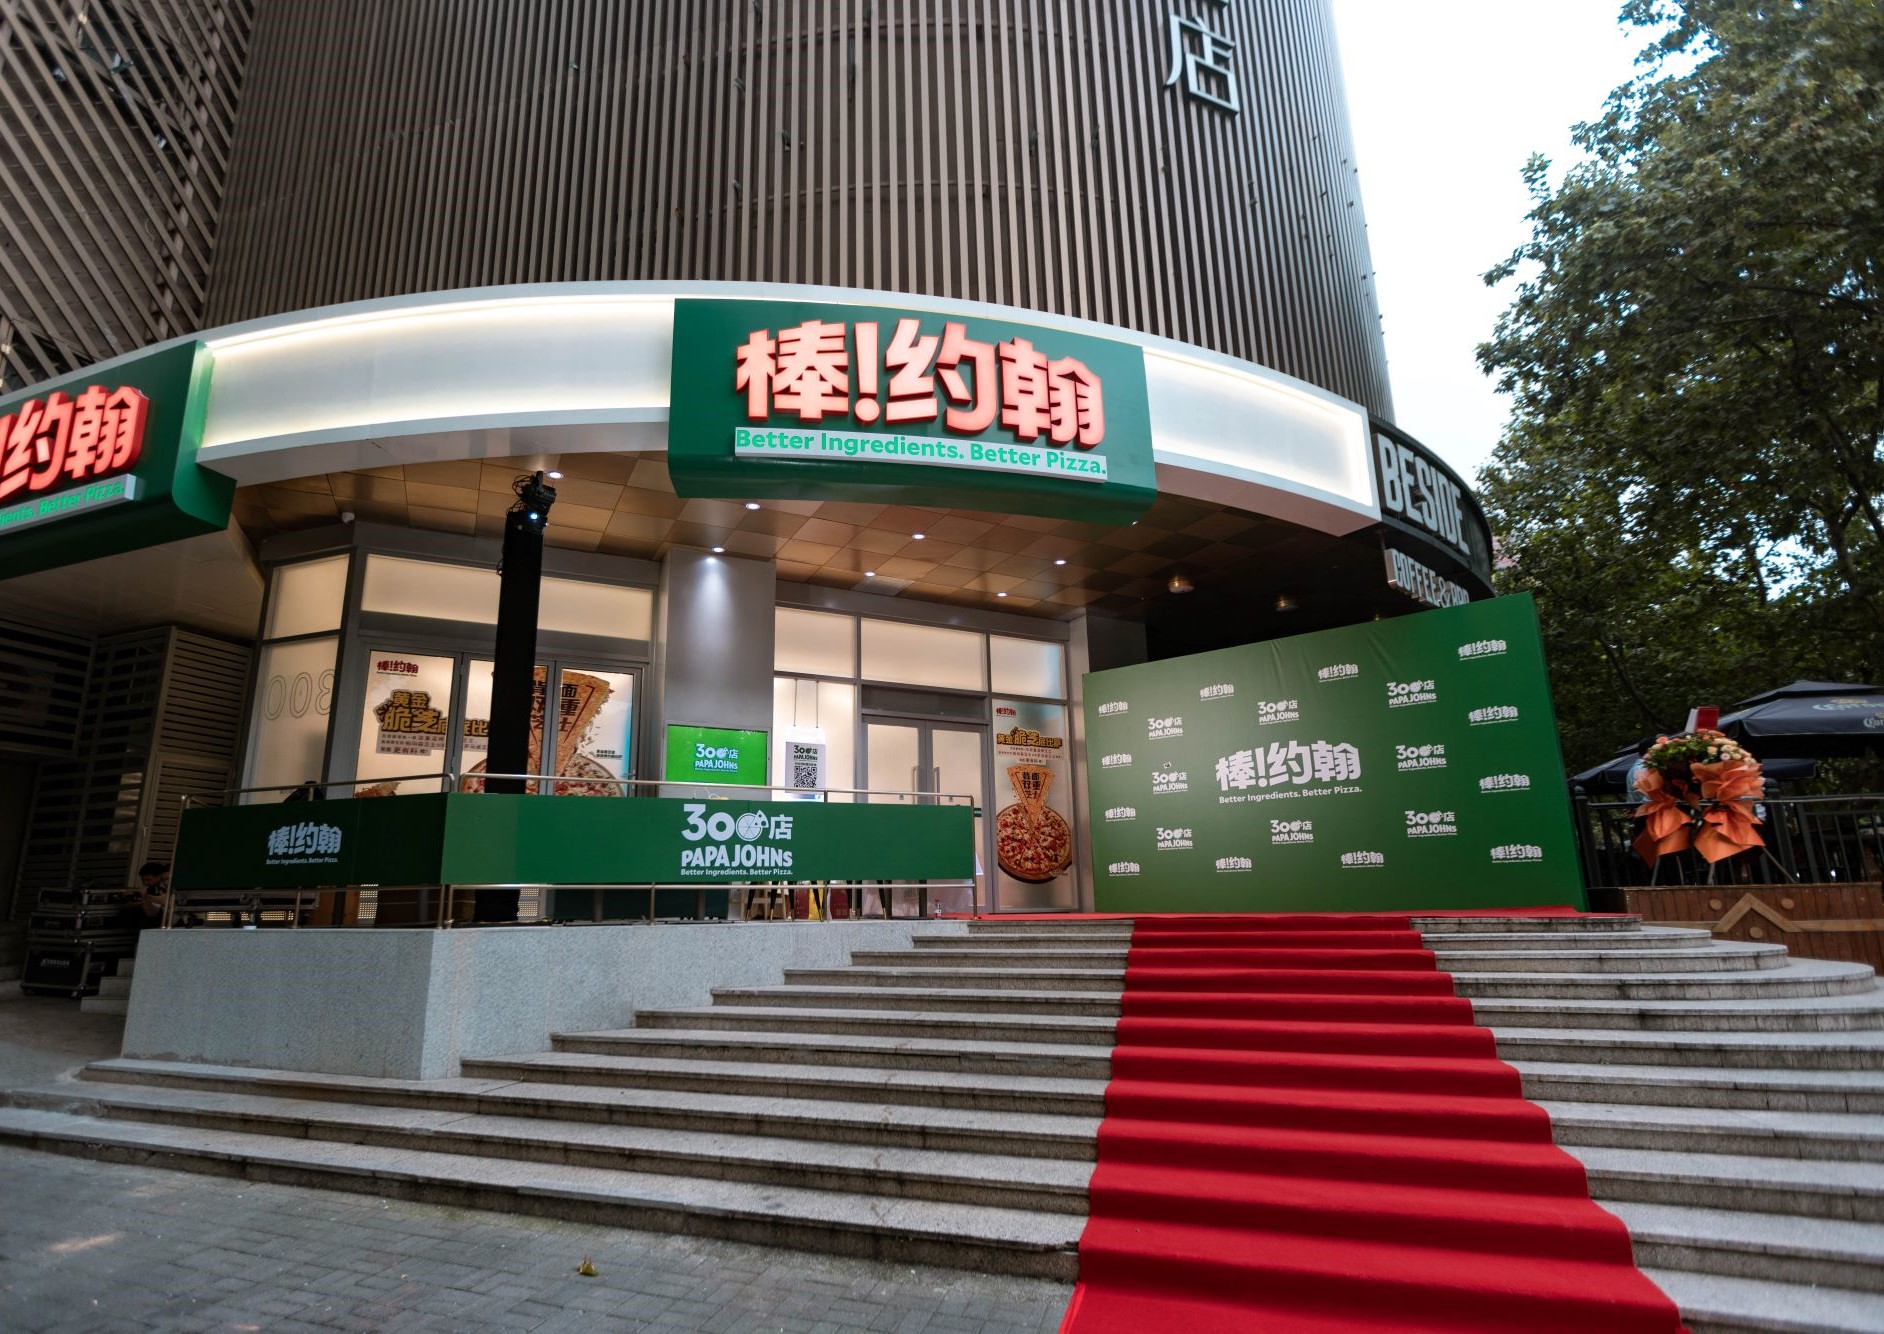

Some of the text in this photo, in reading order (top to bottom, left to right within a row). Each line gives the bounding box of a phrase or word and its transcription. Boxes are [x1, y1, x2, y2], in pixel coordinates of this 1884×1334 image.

[736, 319, 1105, 450] 棒!约翰
[736, 429, 1107, 476] Better Ingredients. Better Pizza.
[38, 493, 82, 516] Better
[85, 480, 125, 503] Pizza.
[1376, 432, 1471, 556] BESIDE
[1388, 548, 1441, 607] COFFEE
[393, 691, 430, 708] 黄金
[1215, 740, 1362, 791] 棒!约翰
[1219, 785, 1363, 804] Better Ingredients. Better Pizza.
[267, 822, 343, 855] 棒!约翰
[680, 868, 704, 876] Better
[706, 868, 748, 876] Ingredients.
[750, 868, 772, 876] Better
